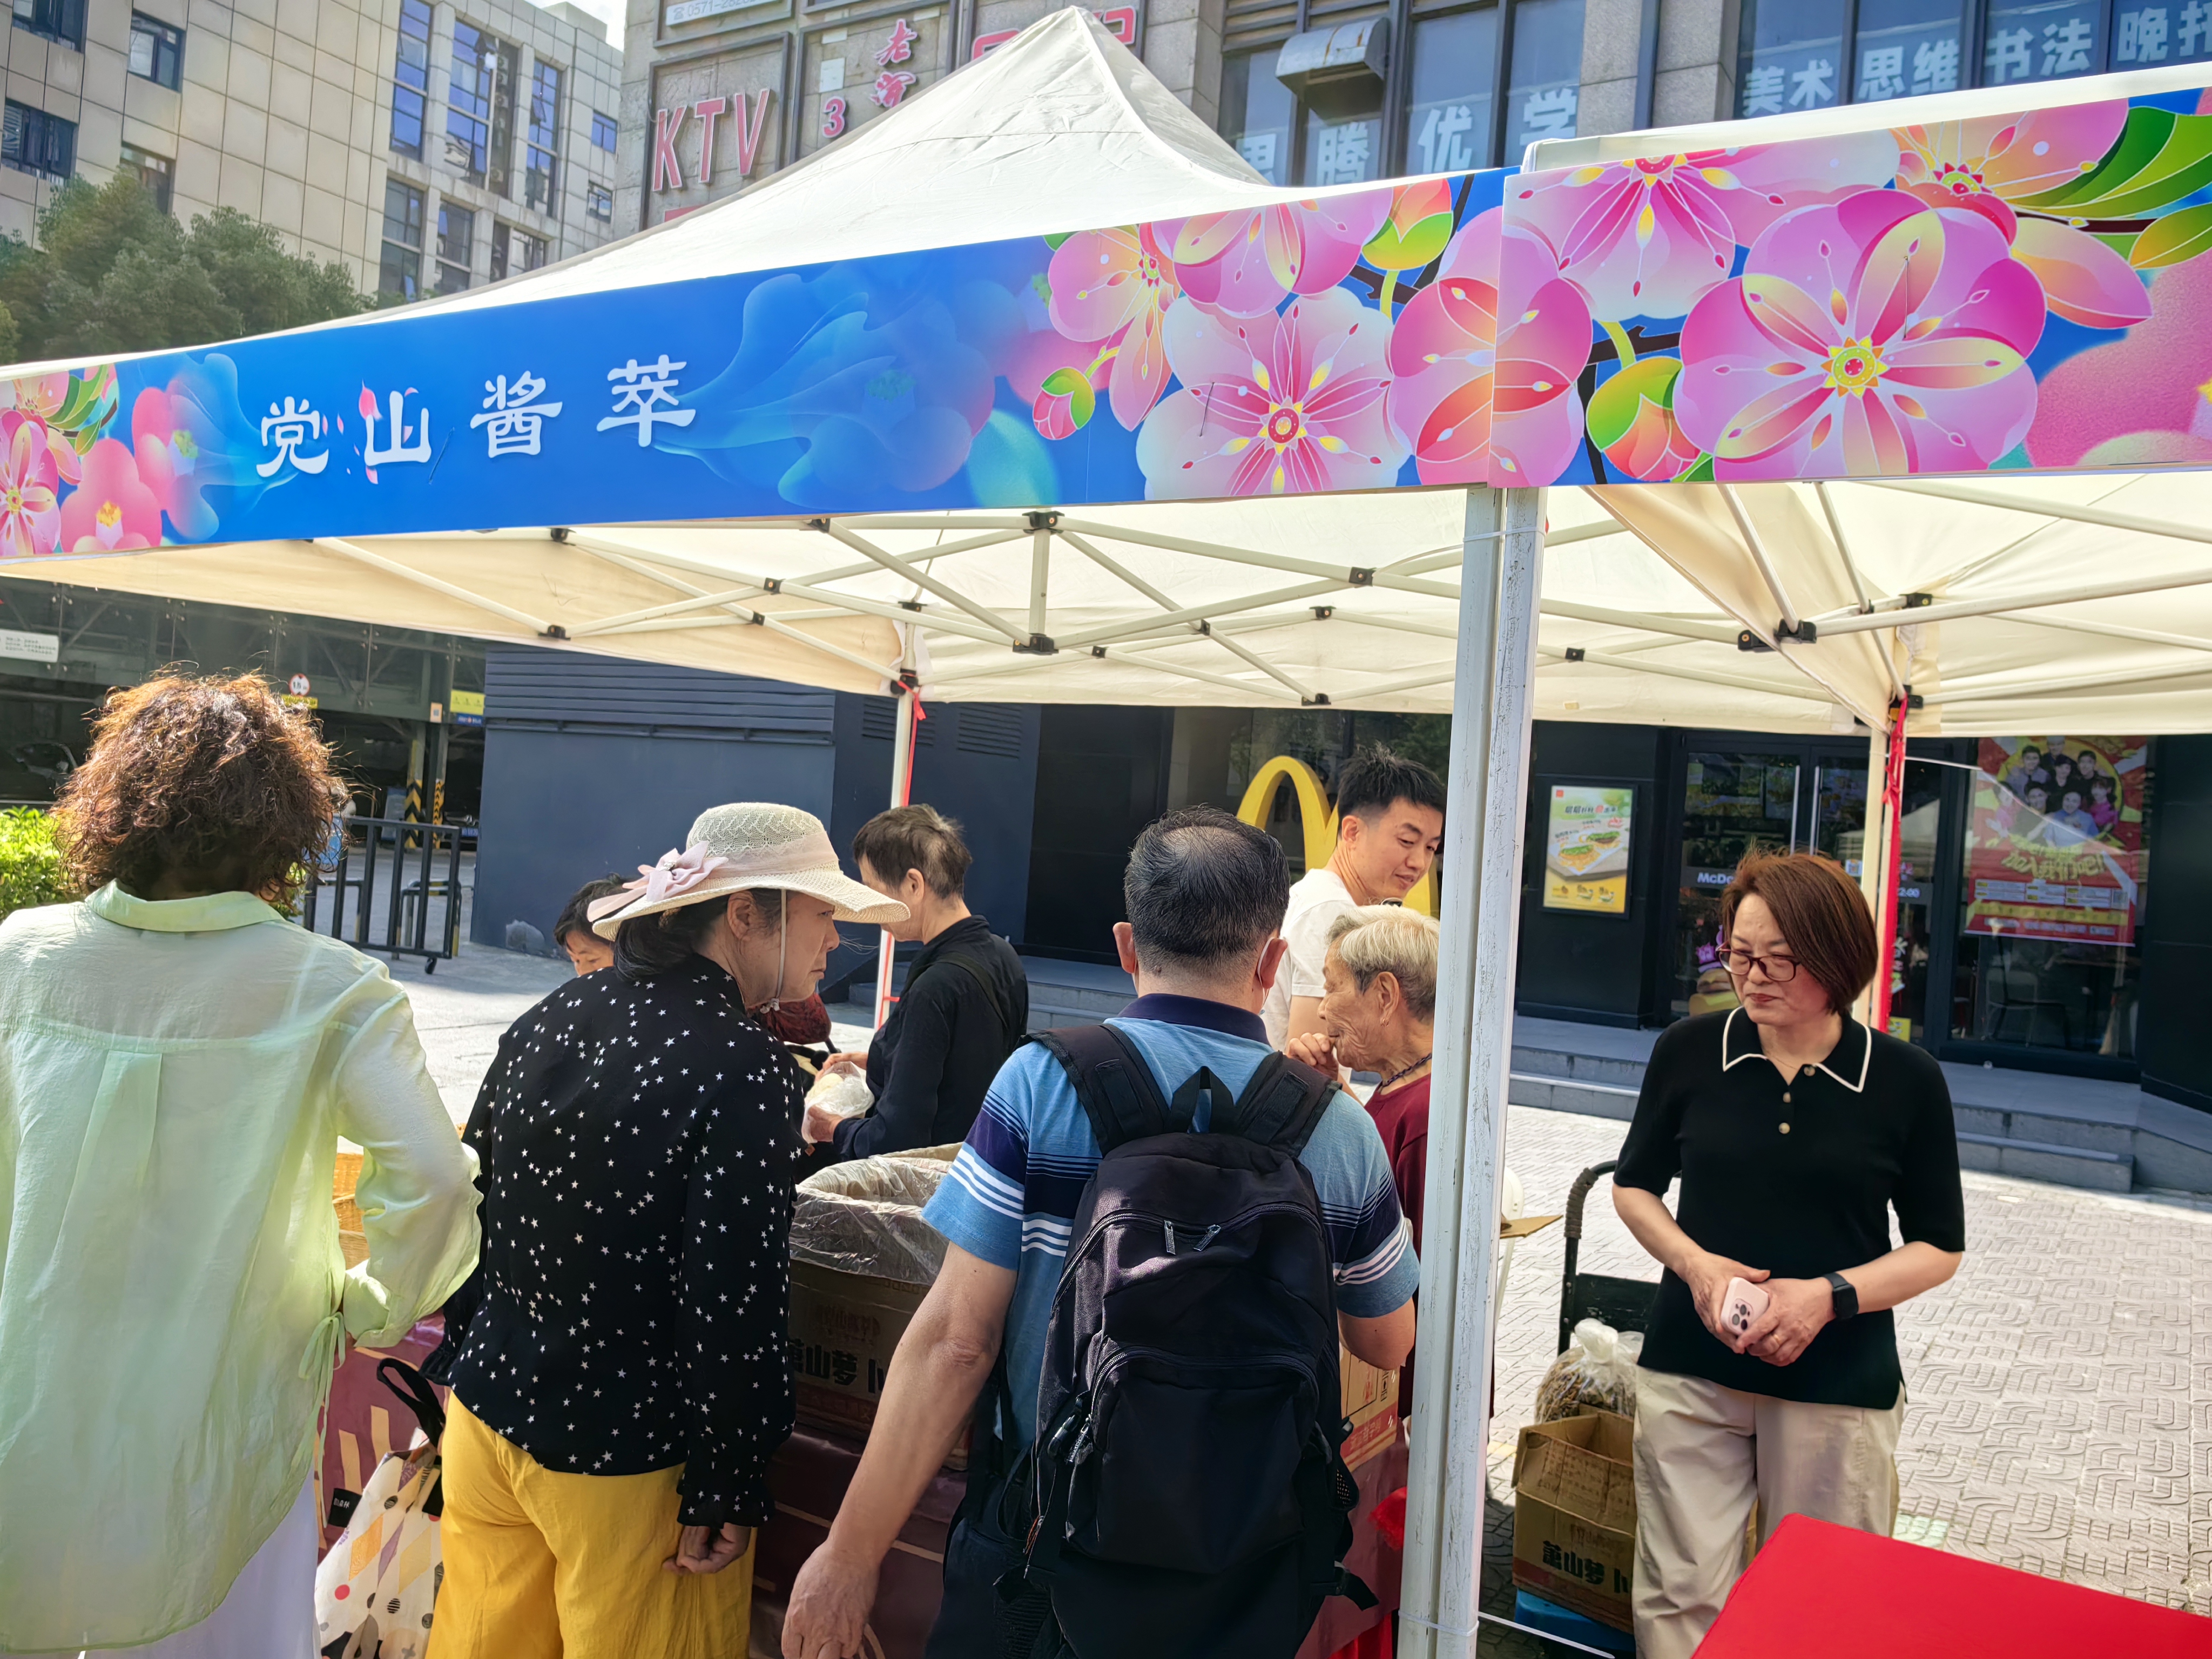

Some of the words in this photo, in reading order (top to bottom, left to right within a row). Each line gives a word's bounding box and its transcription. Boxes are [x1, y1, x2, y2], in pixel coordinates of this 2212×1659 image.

[822, 96, 846, 138] 3
[1742, 59, 1835, 117] 美术
[1859, 39, 1960, 100] 思维
[1985, 18, 2093, 84] 书法
[652, 87, 771, 192] KTV
[256, 354, 697, 477] 党山酱萃
